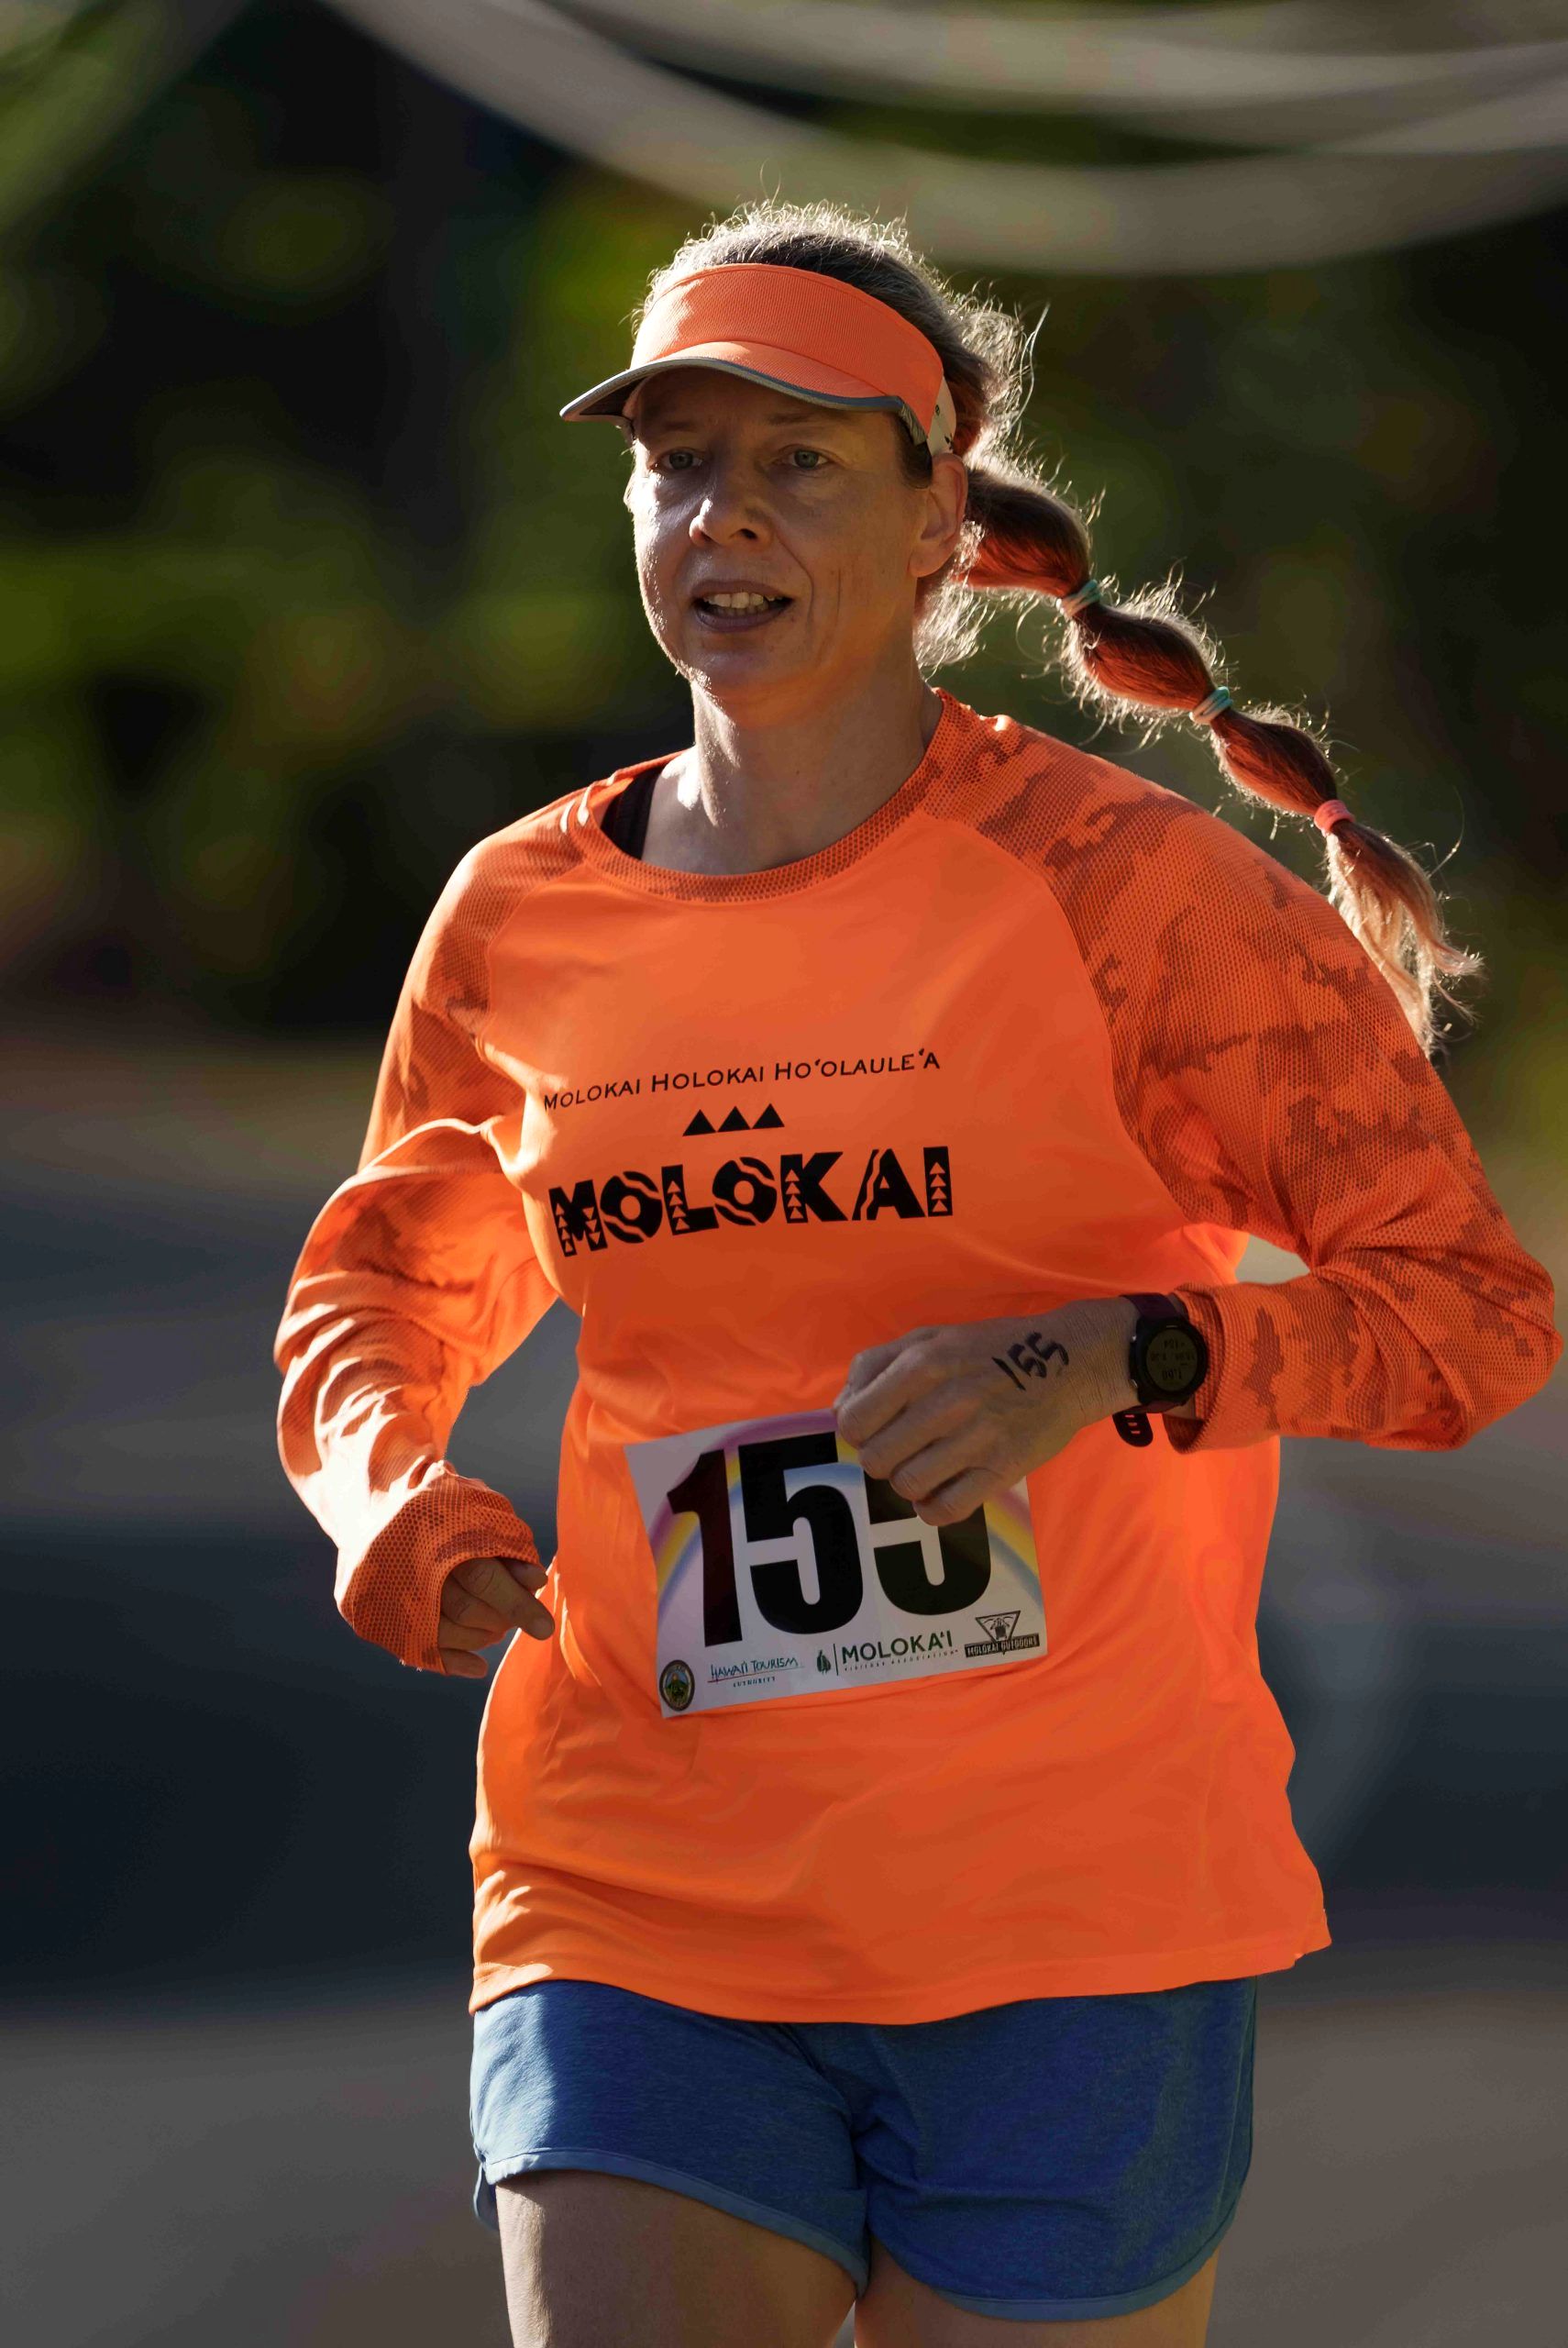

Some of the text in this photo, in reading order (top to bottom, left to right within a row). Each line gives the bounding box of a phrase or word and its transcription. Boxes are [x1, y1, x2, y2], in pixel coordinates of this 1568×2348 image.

[544, 1079, 640, 1112] MOLOKAI
[651, 1066, 764, 1092] HOLOKAI
[548, 1146, 954, 1257] MOLOKAI
[991, 1332, 1069, 1391] 155
[667, 1431, 992, 1647] 155
[750, 1657, 799, 1673] TOURISM
